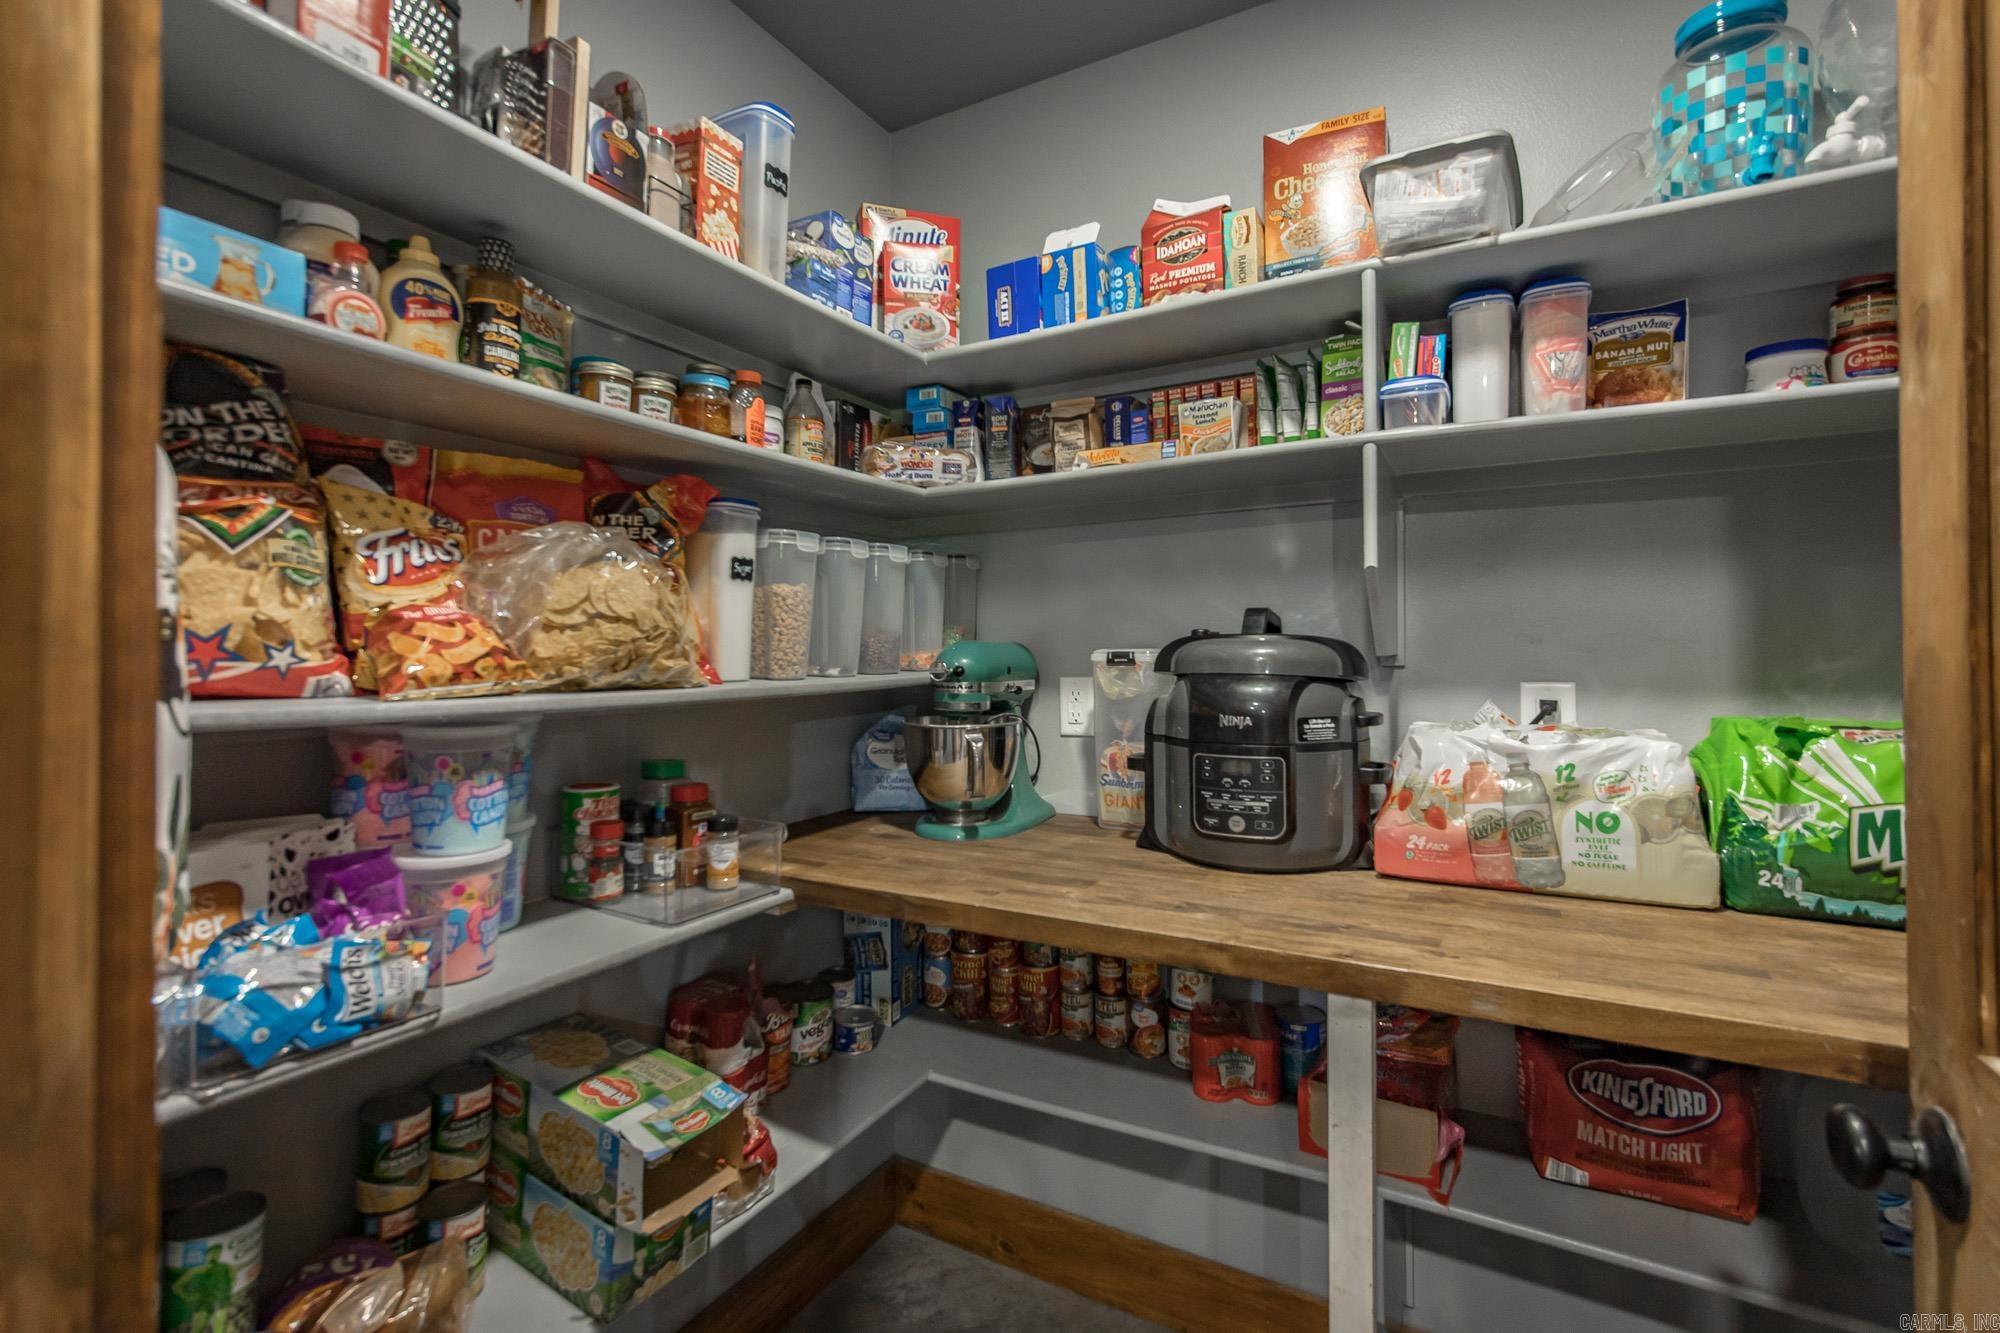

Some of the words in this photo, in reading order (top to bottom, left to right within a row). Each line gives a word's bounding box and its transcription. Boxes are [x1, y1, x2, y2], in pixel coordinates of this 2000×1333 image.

[1320, 117, 1349, 131] FAMILY
[1352, 111, 1370, 124] SIZE
[884, 225, 948, 246] inute
[1156, 234, 1206, 260] IDAHOAN
[891, 258, 949, 277] CREAM
[1168, 262, 1216, 280] PREMIUM
[1237, 254, 1247, 285] RANCH
[892, 273, 949, 292] WHEAT
[1149, 280, 1178, 291] MASHED
[1179, 273, 1216, 286] POTATOES
[1592, 323, 1637, 341] Martha
[1637, 318, 1673, 330] White
[1327, 341, 1346, 350] TWIN
[1347, 338, 1362, 347] PAC
[1595, 346, 1643, 360] BANANA
[1646, 341, 1669, 352] NUT
[209, 399, 277, 425] THE
[1189, 401, 1228, 413] Maruchan
[1195, 417, 1217, 426] Lunch
[900, 459, 934, 470] WONDER
[608, 513, 645, 527] THE
[1218, 713, 1253, 728] NINJA
[1433, 768, 1451, 785] 12
[1557, 763, 1577, 784] 12
[1469, 817, 1508, 841] TWIST
[1575, 809, 1621, 834] NO
[1405, 834, 1426, 849] 24
[1510, 821, 1549, 843] TWIST
[1575, 836, 1622, 846] SYNTHETIC
[1570, 860, 1585, 868] NO
[1586, 861, 1627, 871] CAFFEINE
[1757, 869, 1784, 888] 24
[1581, 1069, 1708, 1117] KINGSFORD
[1576, 1120, 1646, 1161] MATCH
[1650, 1142, 1705, 1166] LIGHT
